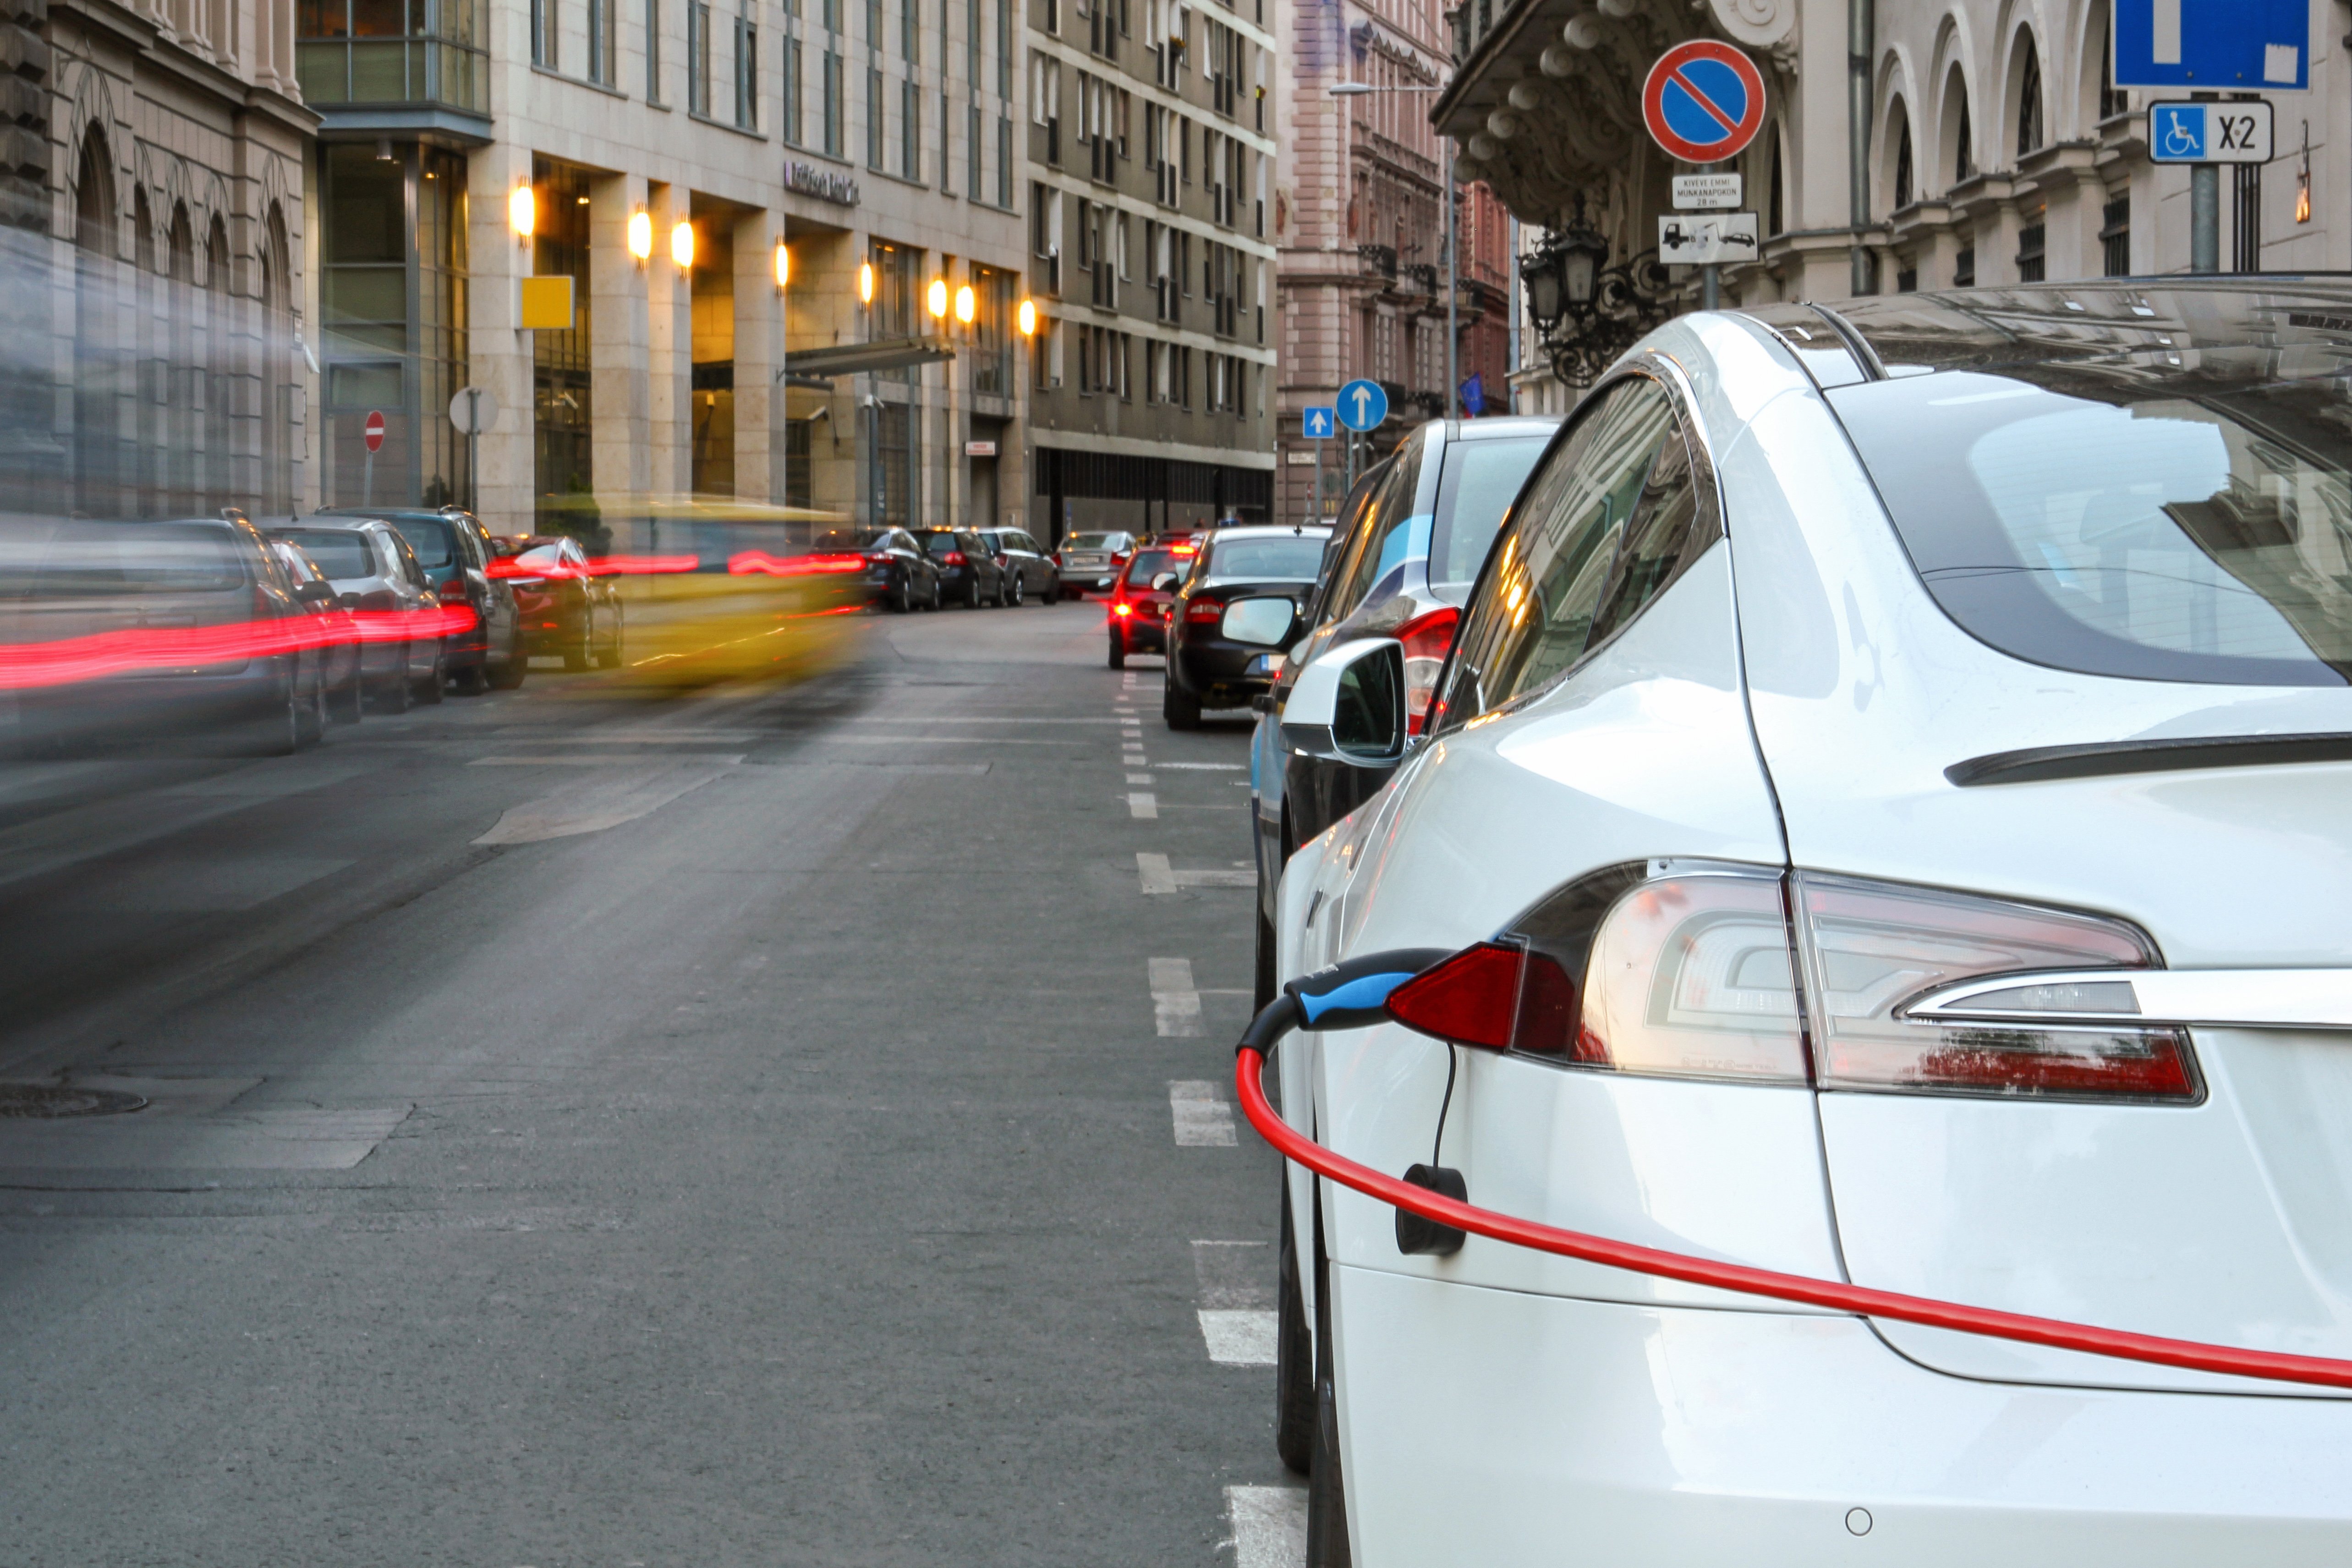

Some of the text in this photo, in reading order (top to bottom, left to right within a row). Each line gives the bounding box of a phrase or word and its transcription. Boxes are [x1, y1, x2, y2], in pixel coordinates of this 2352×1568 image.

[2219, 116, 2256, 149] X2
[1710, 178, 1730, 186] EMMI
[1678, 188, 1736, 197] MUNKANAPOKON
